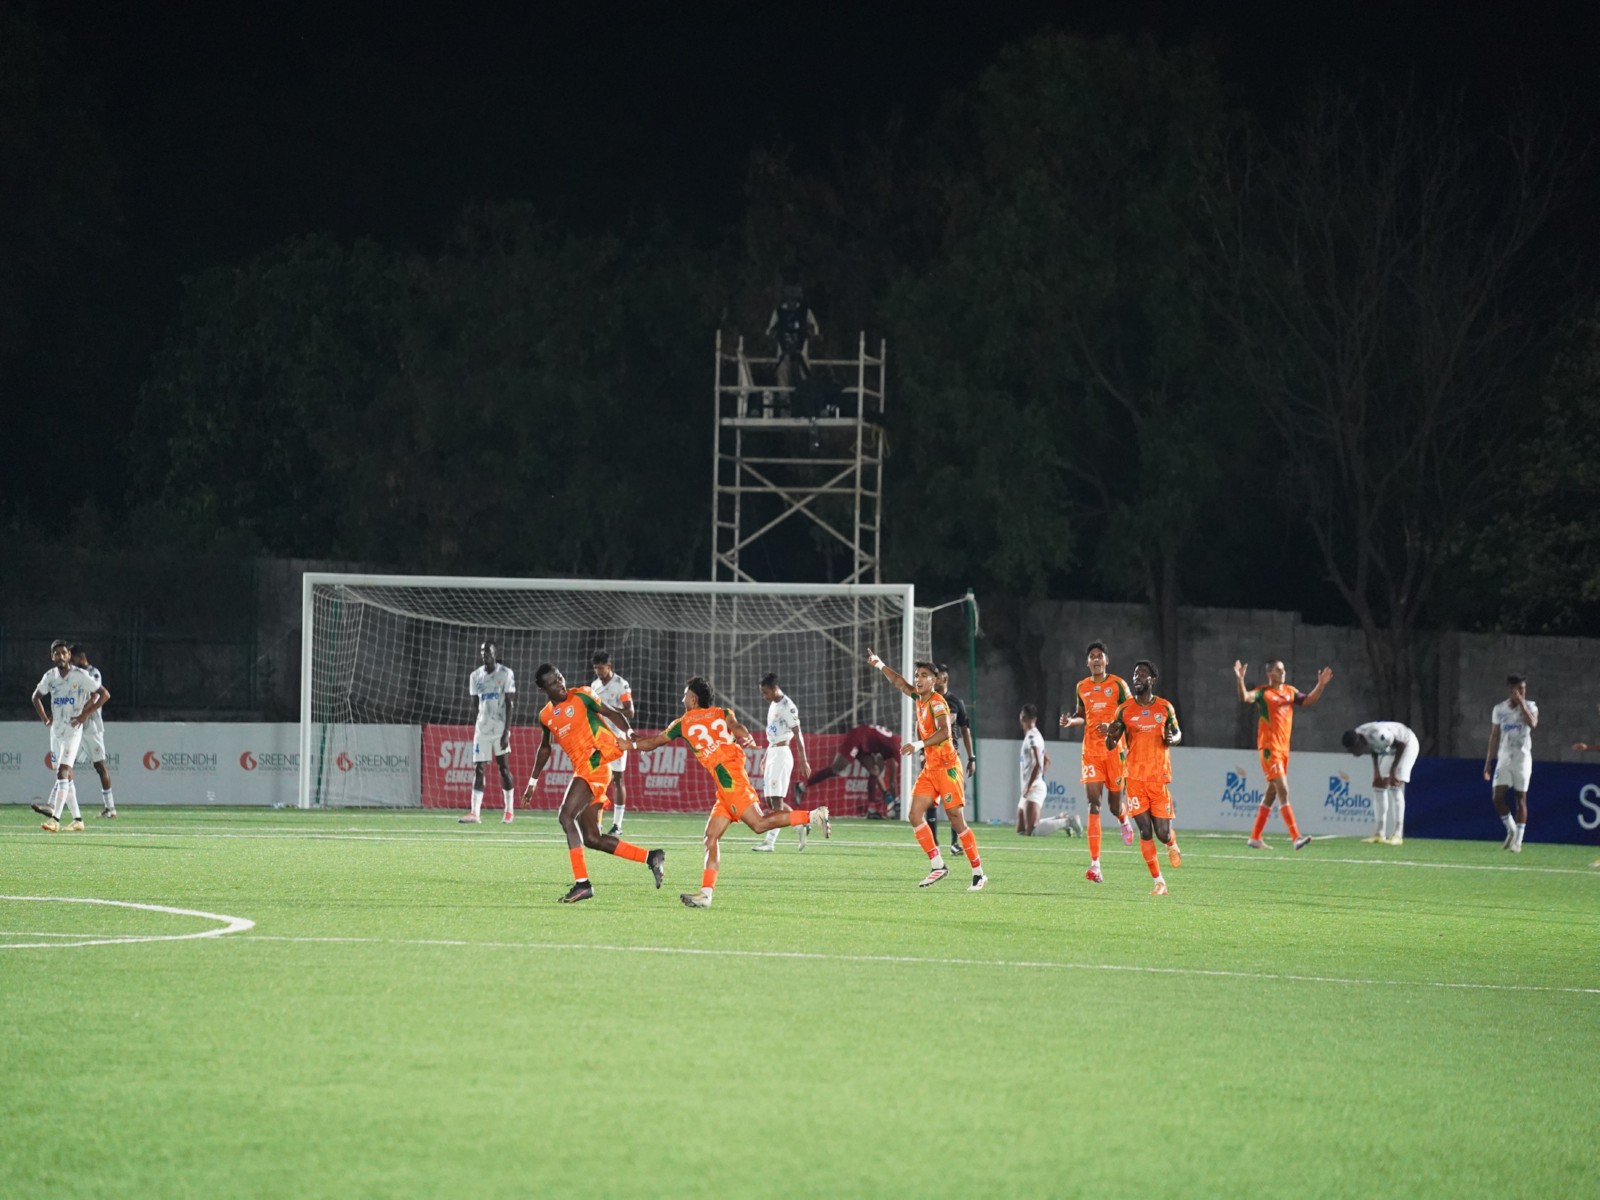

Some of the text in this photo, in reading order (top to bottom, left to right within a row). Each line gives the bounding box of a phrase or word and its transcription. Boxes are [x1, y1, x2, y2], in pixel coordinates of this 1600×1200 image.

[688, 718, 733, 751] 33
[161, 753, 217, 765] SREENIDHI
[258, 753, 313, 766] SREENIDI
[354, 754, 409, 767] SREENIDHI
[438, 741, 474, 769] STA
[638, 746, 687, 774] STAR
[445, 770, 475, 783] CEMEN
[1083, 765, 1095, 778] 23
[645, 775, 679, 789] CEMENT
[1127, 796, 1140, 811] 99
[1324, 793, 1371, 812] Apollo
[1339, 809, 1375, 817] HOSPITAL
